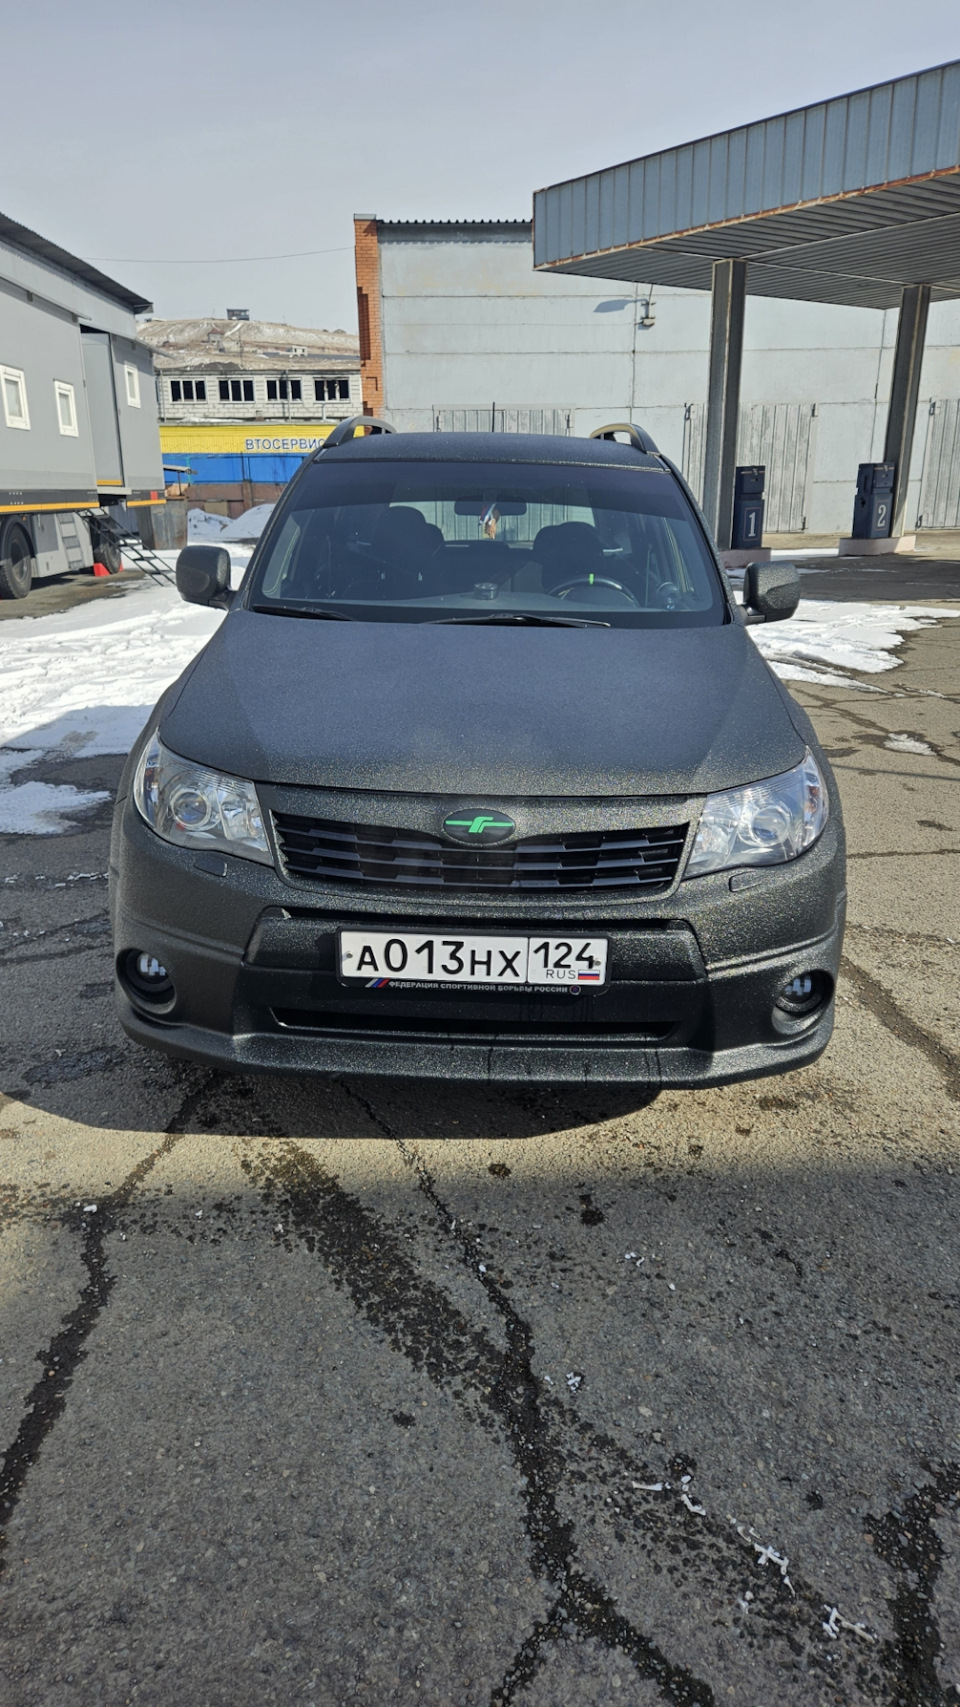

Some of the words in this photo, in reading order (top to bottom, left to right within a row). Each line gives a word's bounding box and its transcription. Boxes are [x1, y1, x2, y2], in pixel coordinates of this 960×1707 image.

[748, 512, 756, 537] 1
[877, 504, 886, 527] 2
[356, 938, 521, 977] А013НХ
[533, 941, 594, 969] 124
[545, 969, 576, 979] RUS
[388, 981, 438, 989] ФЕДЕРАЦИЯ
[440, 983, 496, 991] СПОРТИВНОЙ
